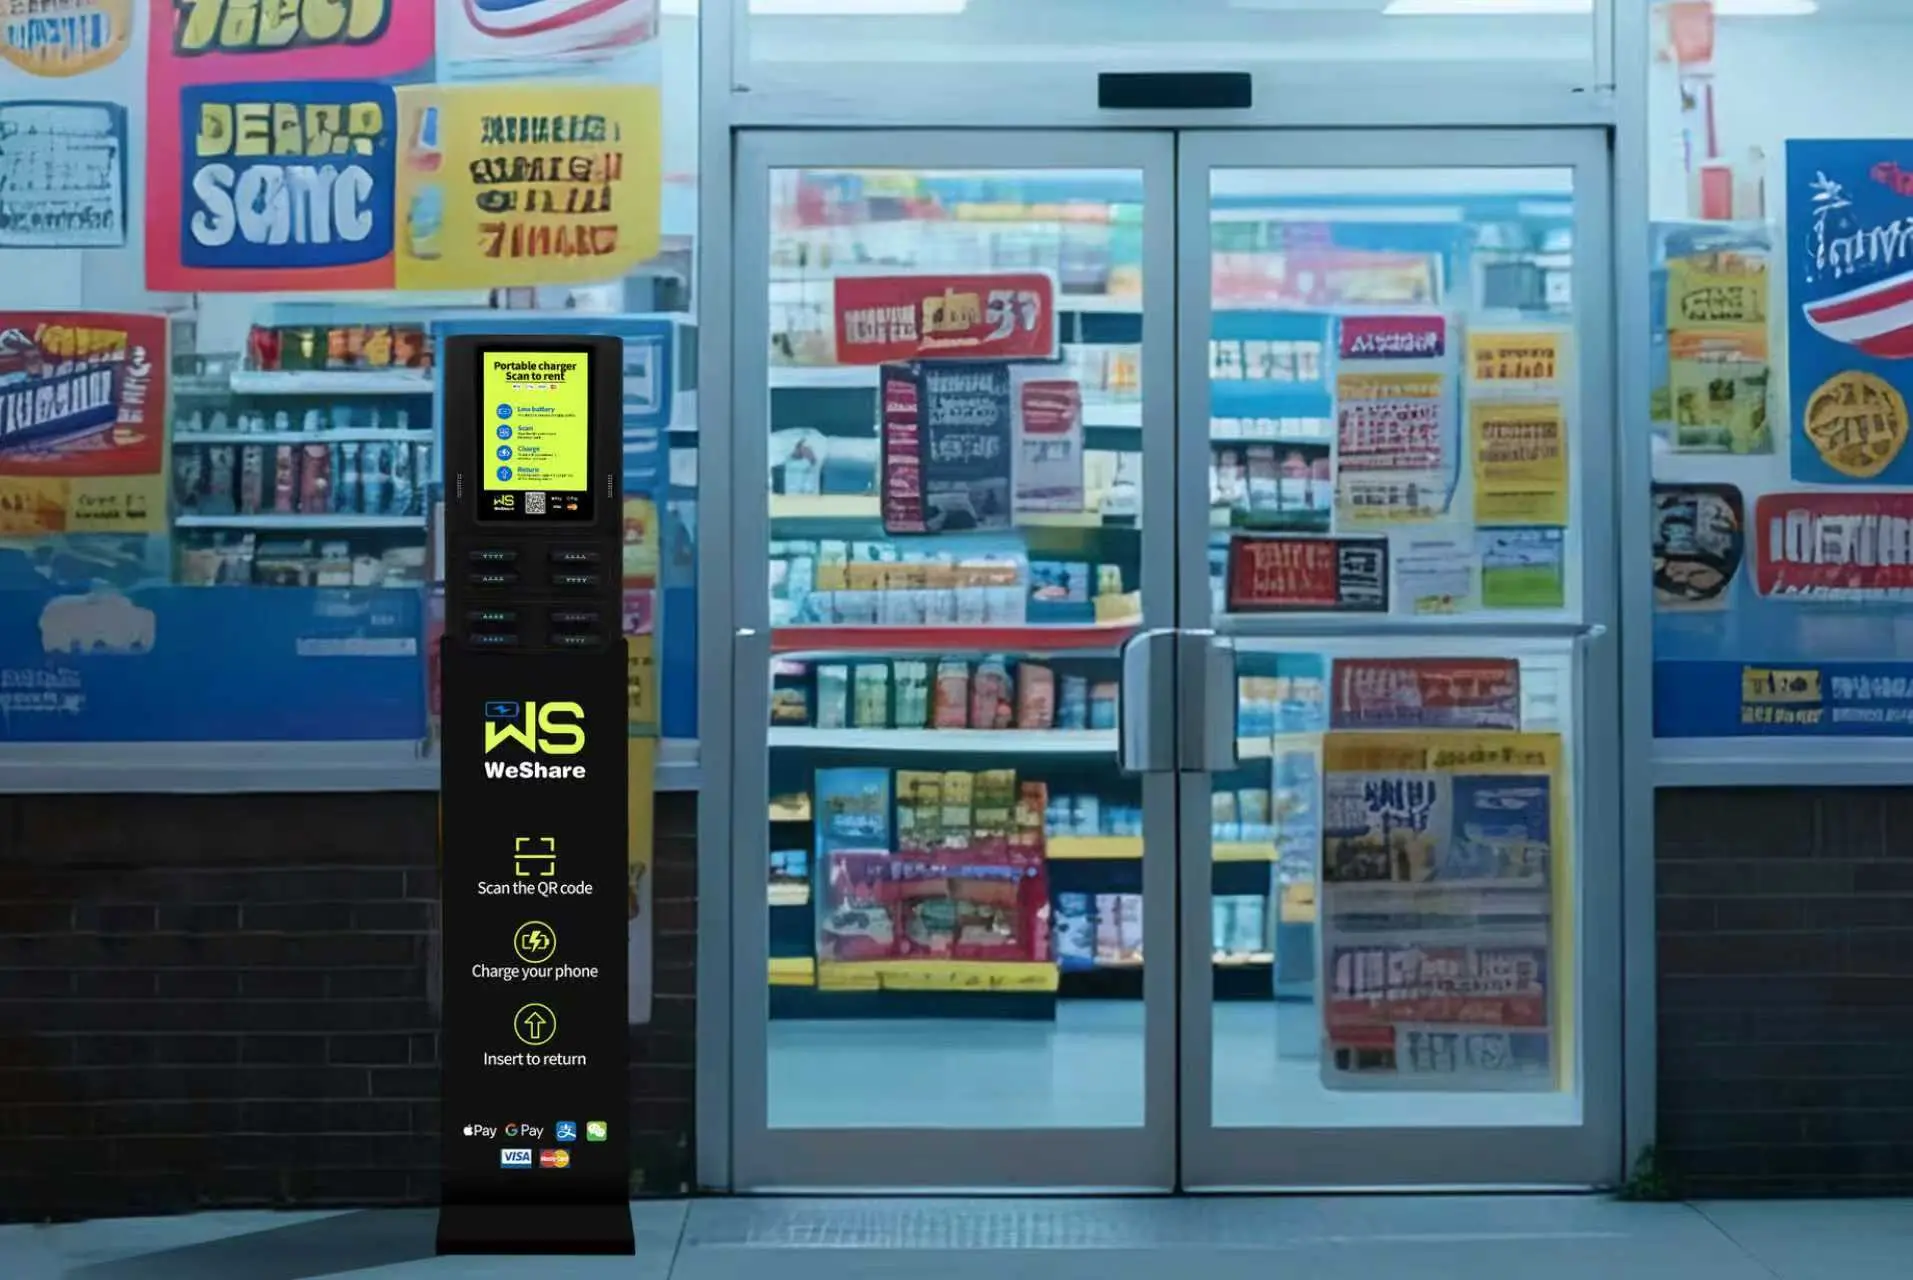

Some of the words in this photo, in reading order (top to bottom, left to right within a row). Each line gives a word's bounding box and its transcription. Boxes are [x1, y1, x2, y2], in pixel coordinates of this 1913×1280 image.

[494, 361, 537, 371] Portable
[538, 361, 577, 373] charger
[506, 372, 530, 381] Scan
[531, 372, 542, 381] to
[543, 372, 566, 381] rent
[517, 446, 540, 454] Charge
[484, 761, 586, 779] WeShare
[478, 881, 510, 895] Scan
[512, 881, 536, 895] the
[537, 881, 558, 898] QR
[560, 880, 593, 895] code
[471, 963, 520, 982] Charge
[521, 966, 554, 981] your
[555, 963, 599, 981] phone
[483, 1051, 524, 1066] Insert
[526, 1053, 541, 1066] to
[543, 1053, 587, 1066] return
[473, 1123, 498, 1139] Pay
[503, 1151, 530, 1162] VISA
